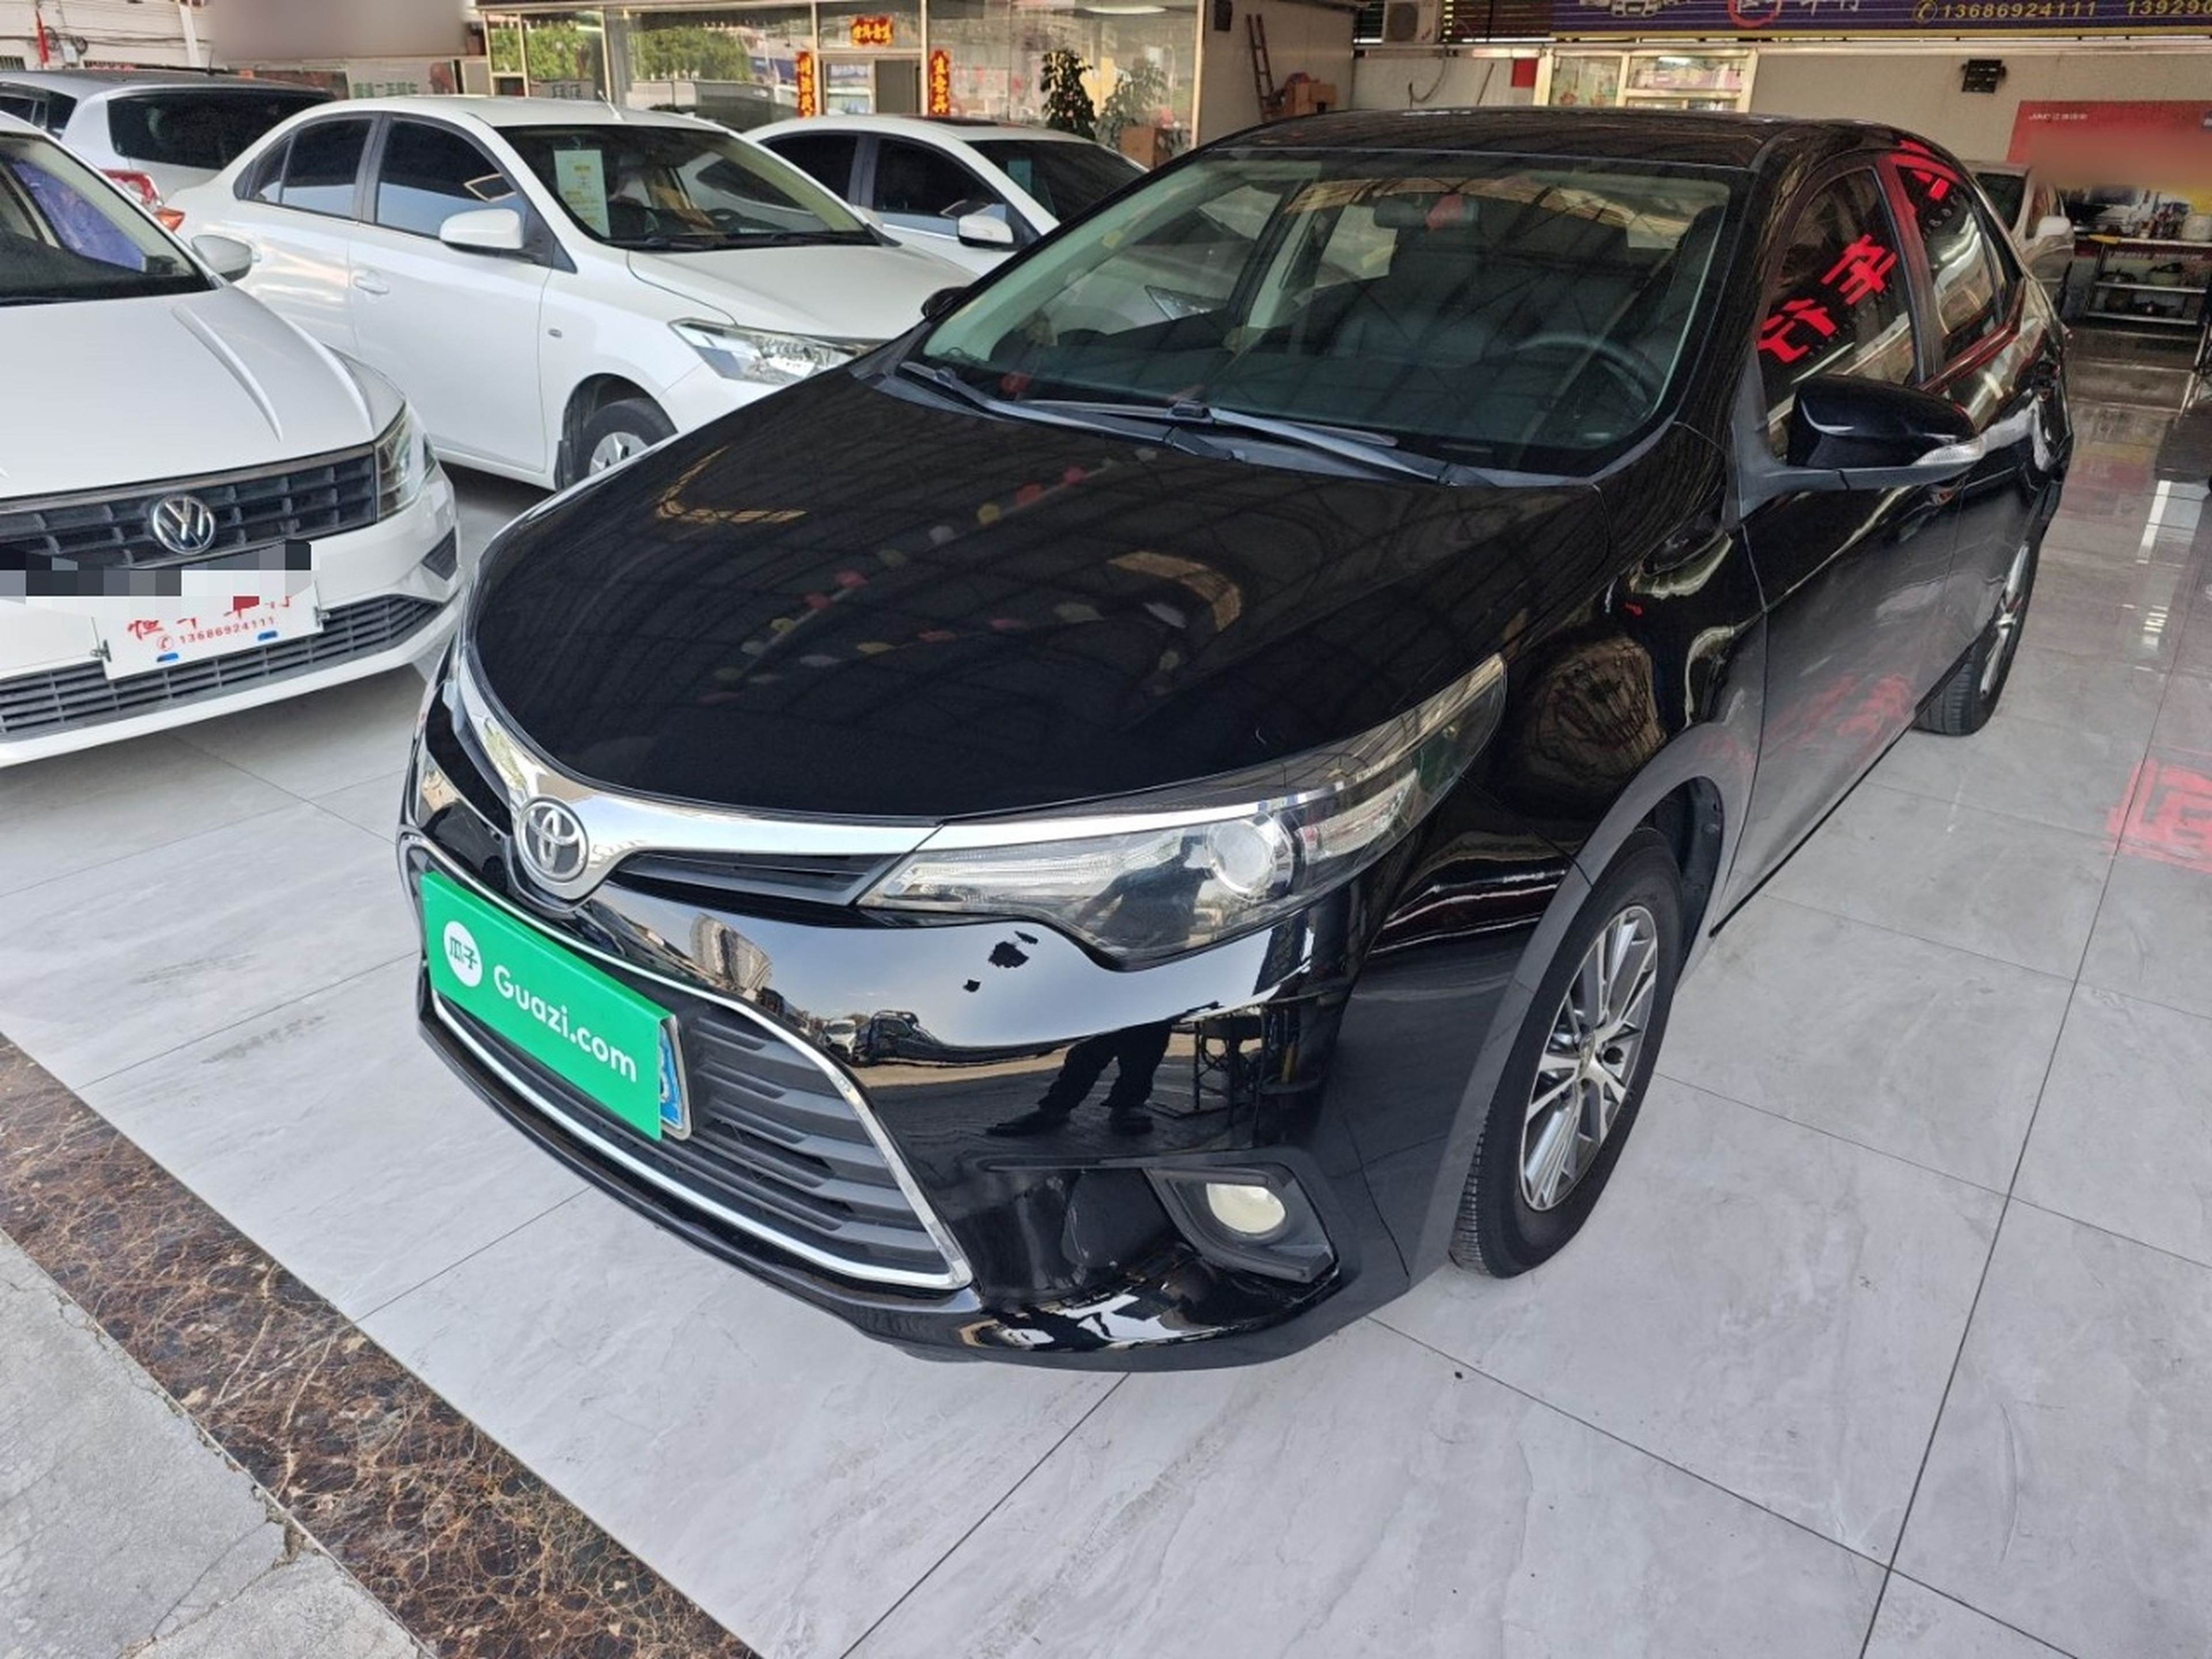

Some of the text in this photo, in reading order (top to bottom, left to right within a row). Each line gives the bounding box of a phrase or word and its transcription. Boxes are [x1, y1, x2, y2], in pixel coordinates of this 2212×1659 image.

[1944, 2, 2097, 18] 13686924111
[179, 616, 274, 645] 13686924111
[449, 936, 478, 970] 瓜子
[494, 964, 637, 1082] Guazi.com
